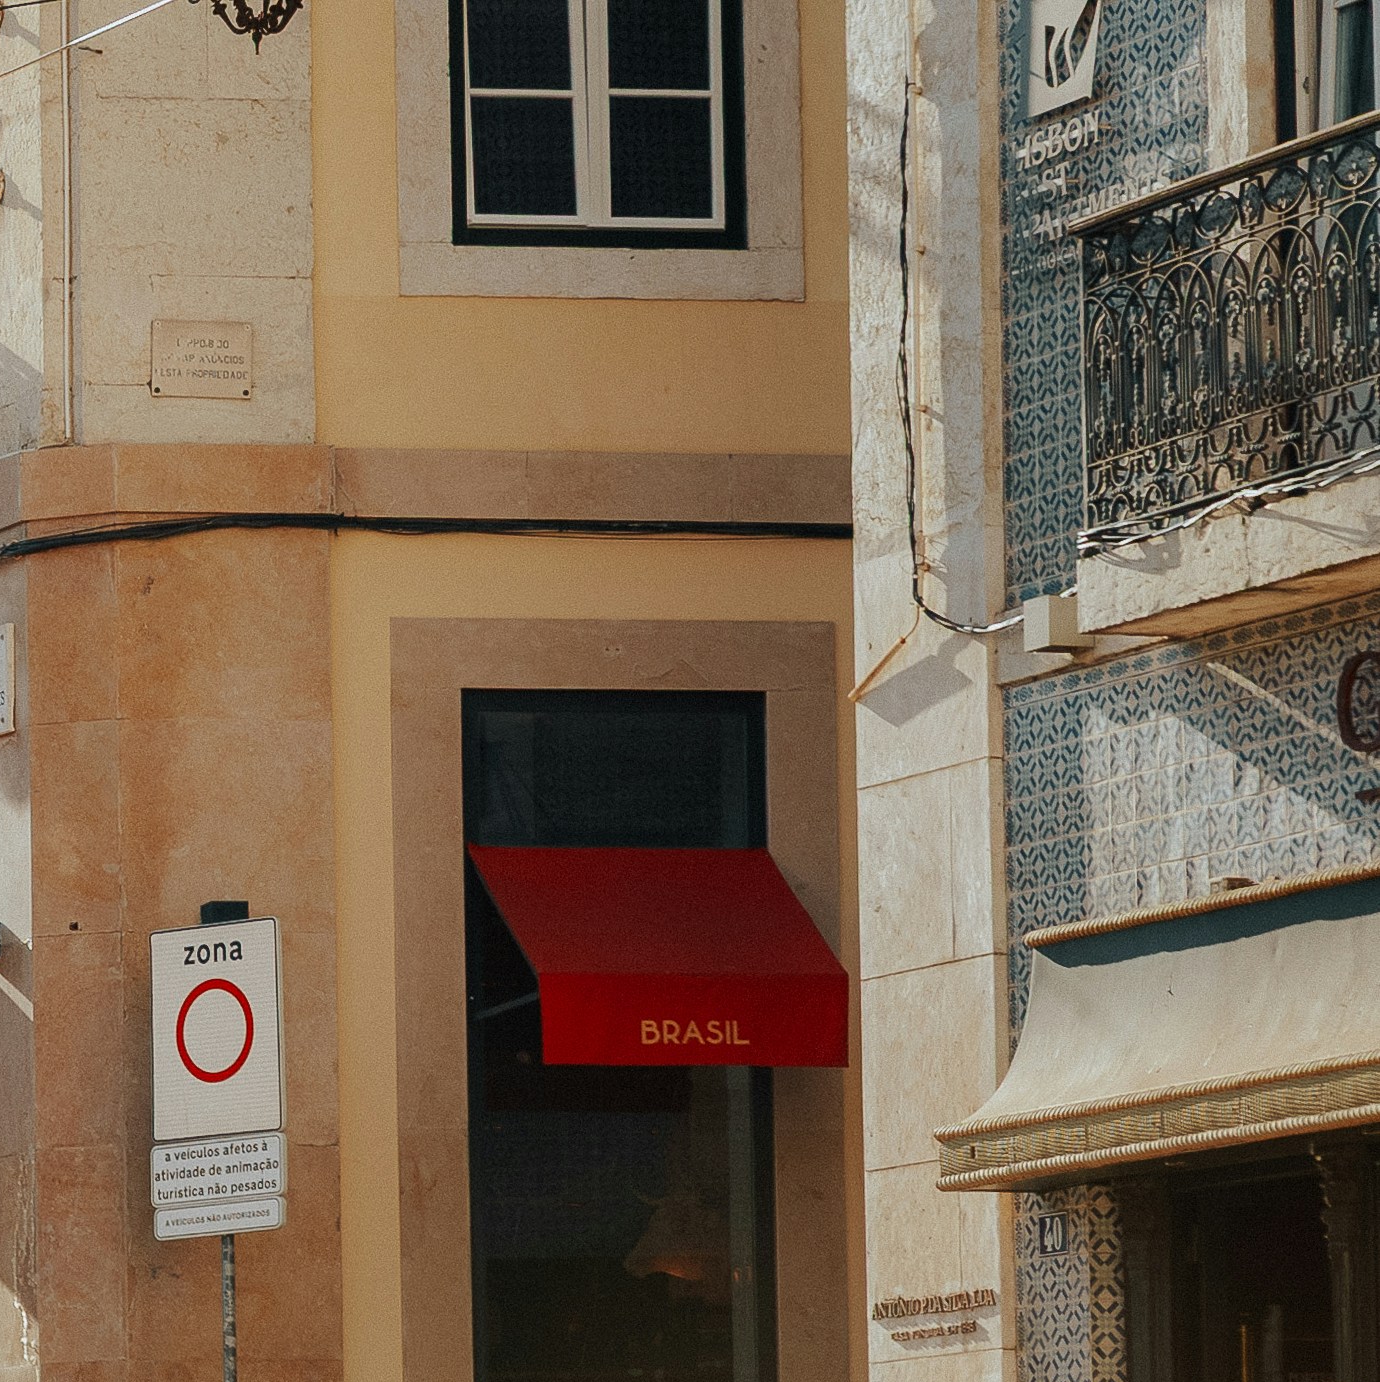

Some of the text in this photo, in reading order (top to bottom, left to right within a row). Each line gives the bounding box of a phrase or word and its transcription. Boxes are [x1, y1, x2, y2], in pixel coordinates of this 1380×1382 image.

[183, 939, 244, 966] zona
[640, 1019, 751, 1046] BRASIL
[165, 1152, 171, 1163] a
[223, 1141, 259, 1156] afetos
[155, 1158, 280, 1182] atividade de animação
[207, 1182, 228, 1196] não
[230, 1178, 278, 1195] pesados
[1044, 1217, 1063, 1251] 40
